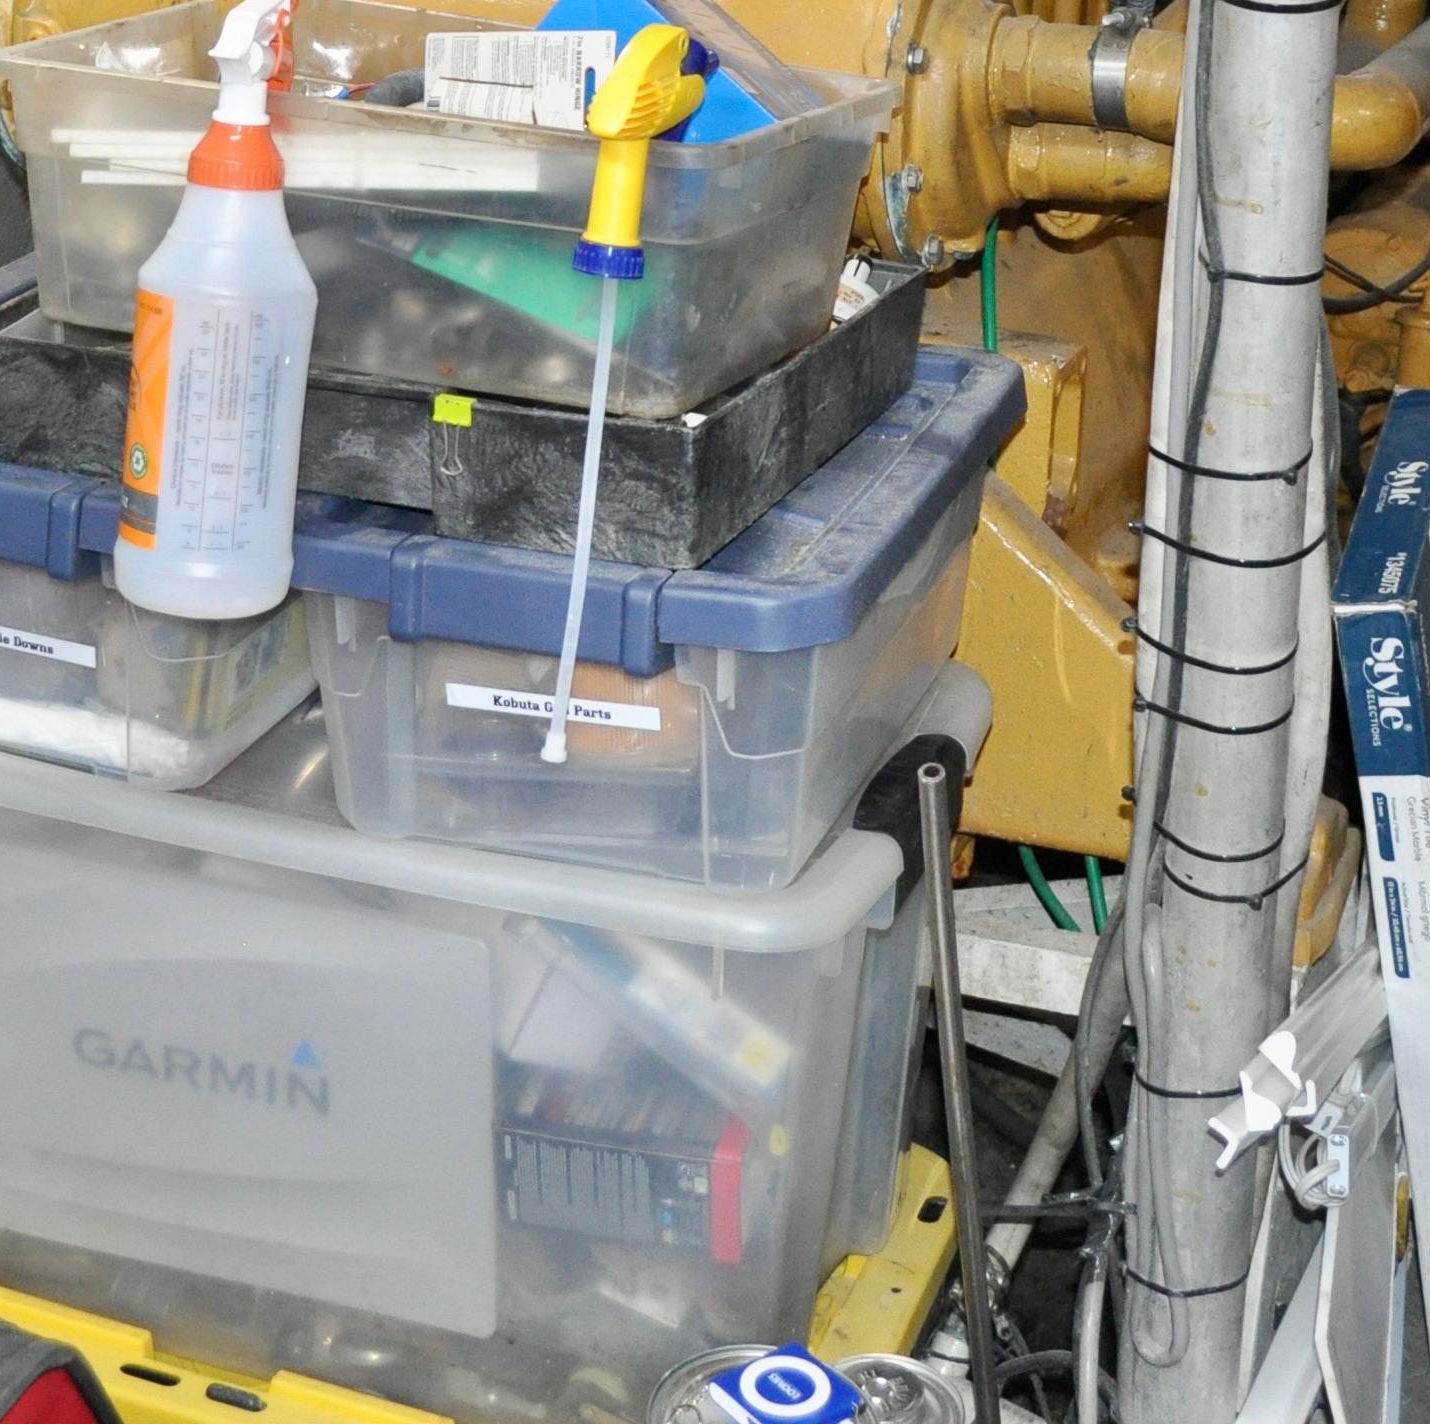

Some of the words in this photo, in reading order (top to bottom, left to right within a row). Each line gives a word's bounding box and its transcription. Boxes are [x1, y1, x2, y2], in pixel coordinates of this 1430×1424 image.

[1384, 461, 1429, 505] Style
[13, 636, 54, 655] Downs
[1362, 637, 1412, 730] Style
[492, 694, 540, 712] Kobuta
[574, 705, 611, 720] Parts
[1365, 688, 1383, 747] SELECTIONS
[1406, 796, 1417, 830] Grecian
[1411, 831, 1422, 862] Marble
[73, 1028, 331, 1116] GARMIN
